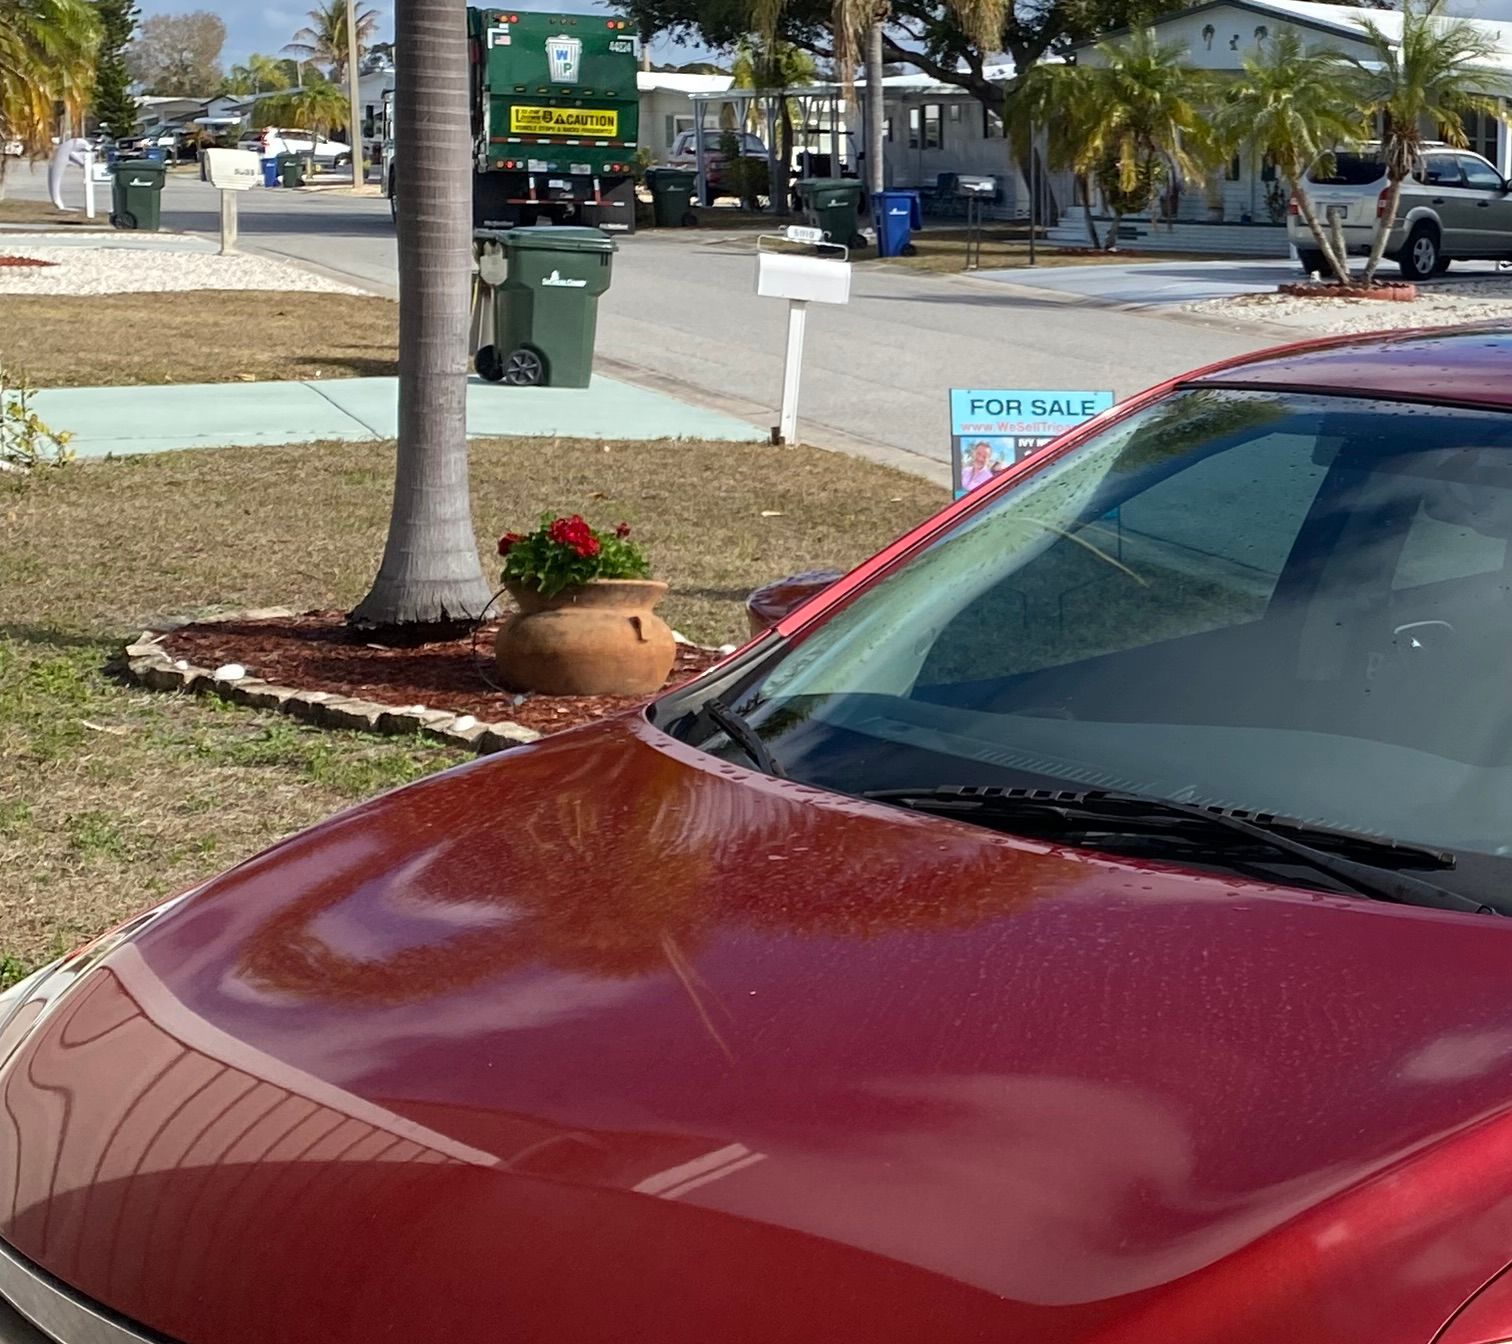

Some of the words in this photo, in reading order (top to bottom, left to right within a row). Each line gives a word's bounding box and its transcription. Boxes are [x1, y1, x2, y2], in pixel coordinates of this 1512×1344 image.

[555, 50, 569, 61] W
[564, 63, 573, 74] P
[566, 114, 615, 127] CAUTION
[970, 399, 1022, 416] FOR
[1031, 399, 1096, 416] SALE
